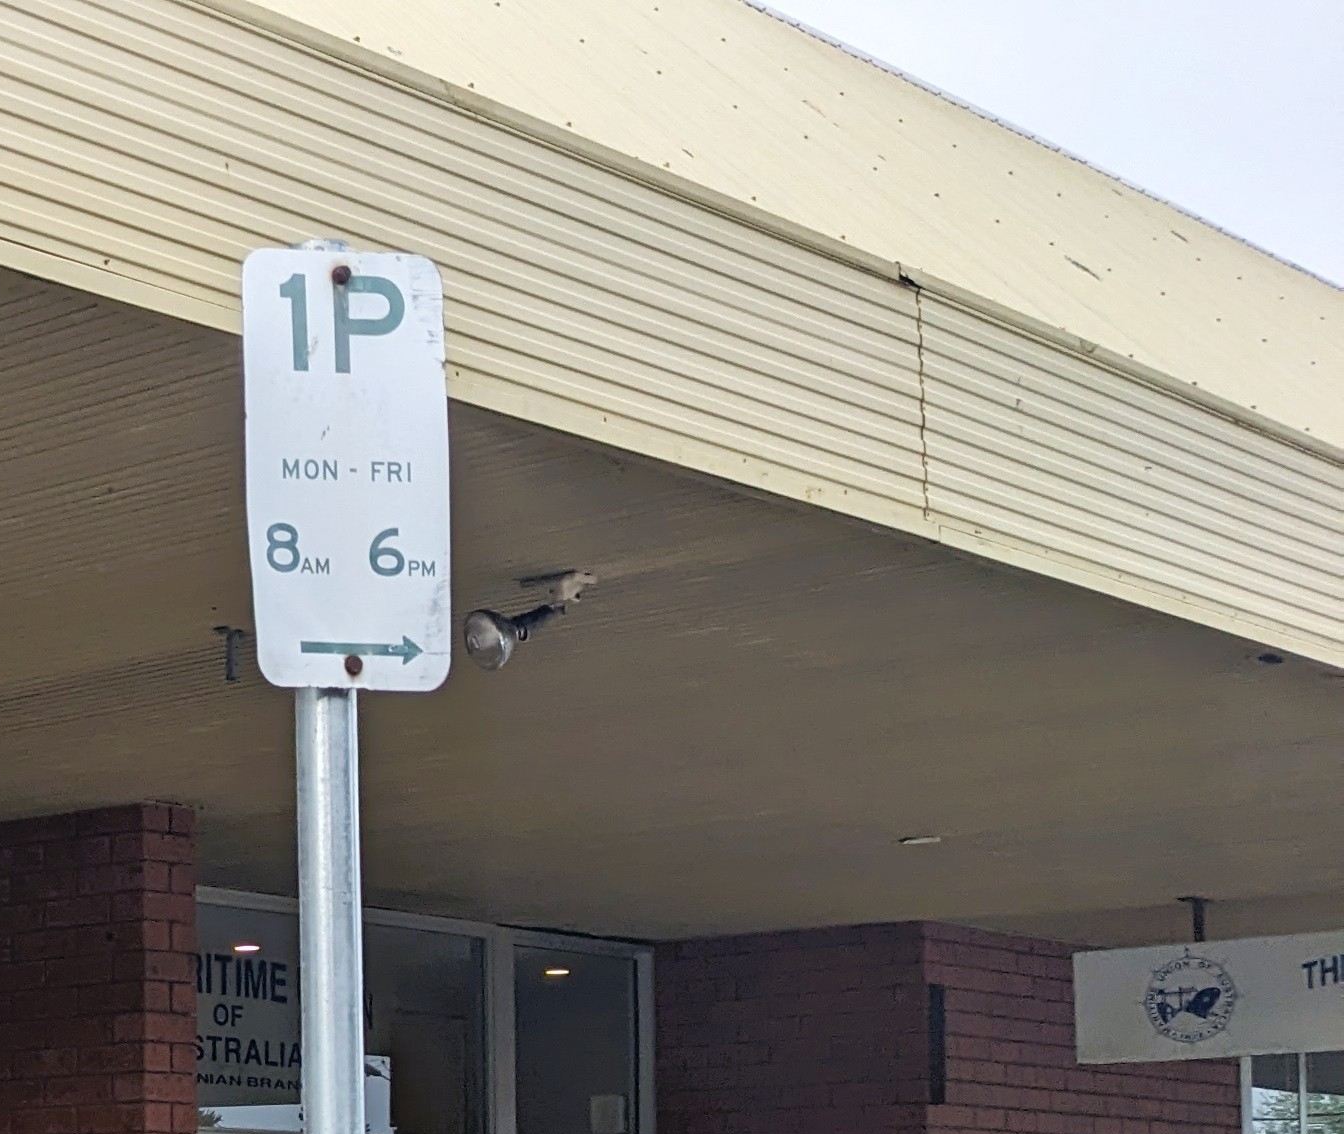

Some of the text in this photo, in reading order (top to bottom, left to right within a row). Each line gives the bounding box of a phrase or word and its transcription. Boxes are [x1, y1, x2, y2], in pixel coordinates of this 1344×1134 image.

[280, 273, 405, 374] 1P
[282, 458, 338, 481] MON
[371, 461, 413, 483] FRI
[1302, 953, 1344, 989] TH
[213, 1003, 244, 1027] OF
